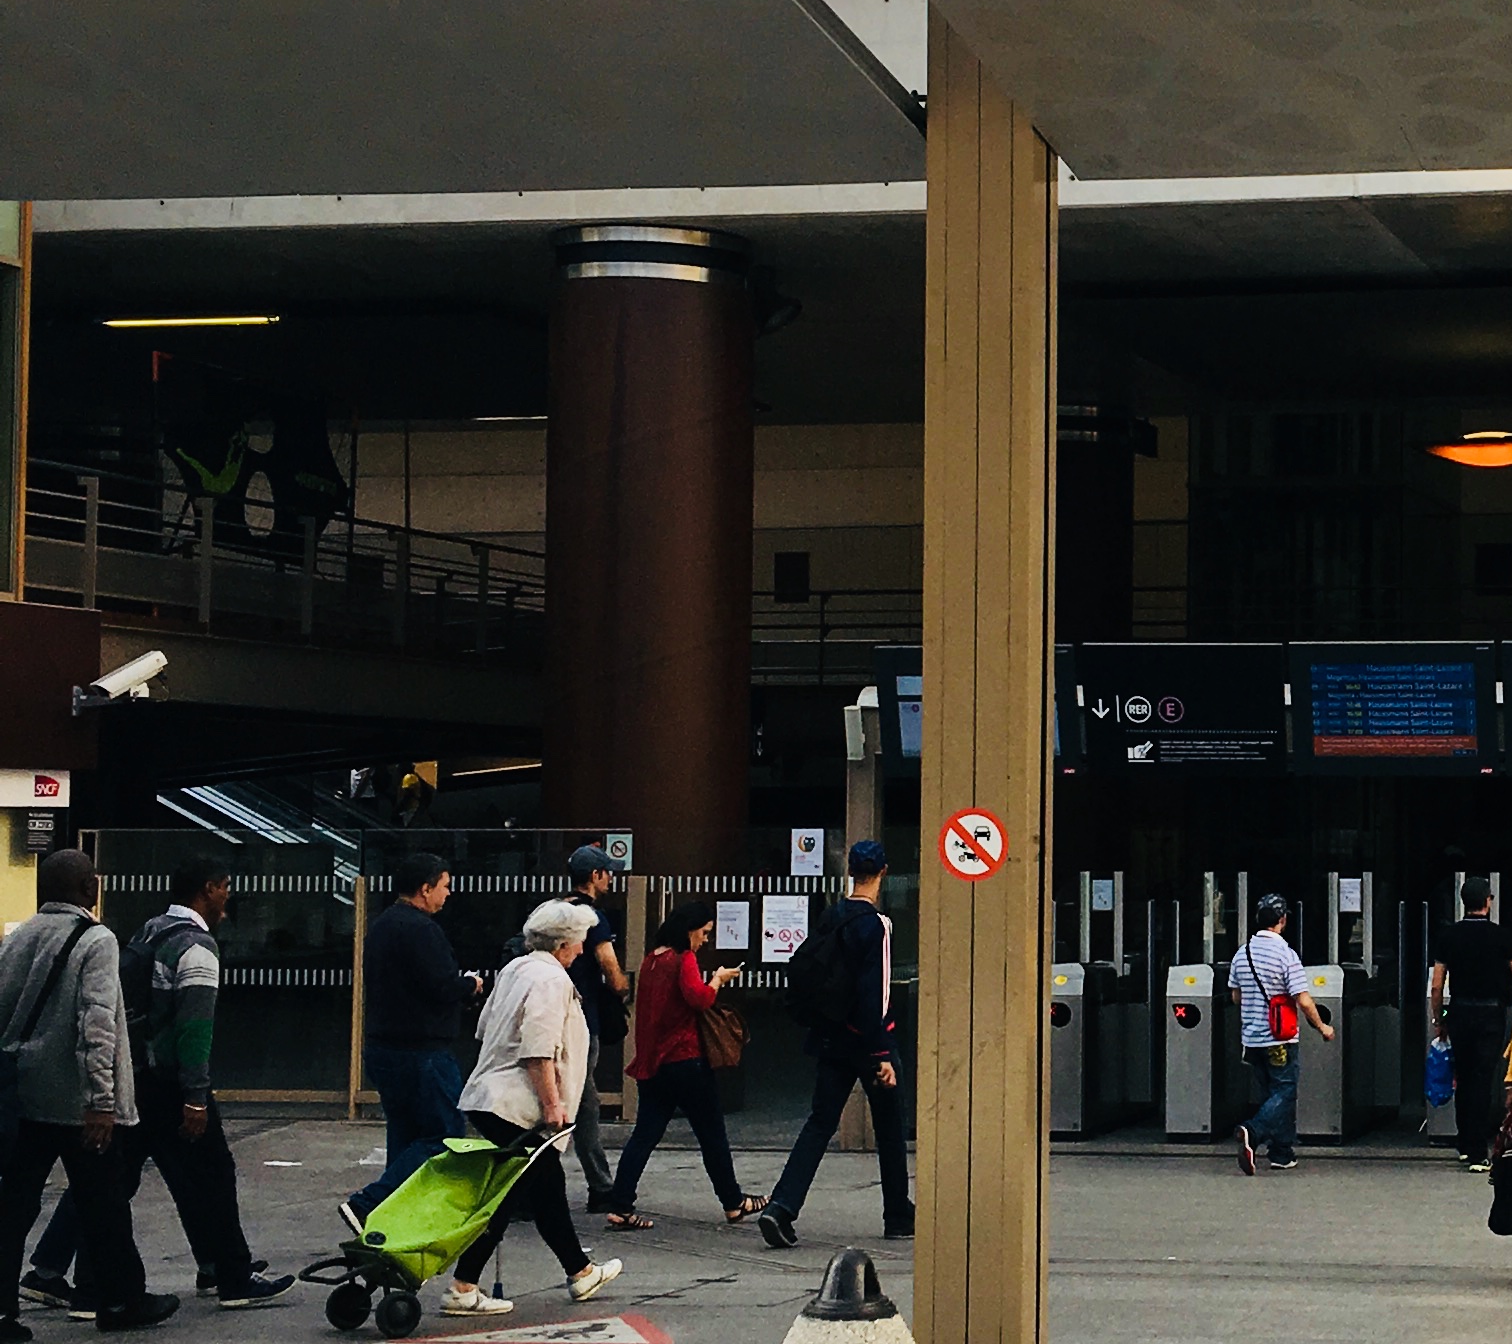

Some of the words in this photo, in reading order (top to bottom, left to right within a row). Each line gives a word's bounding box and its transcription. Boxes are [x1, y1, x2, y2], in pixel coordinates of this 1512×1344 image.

[1128, 704, 1148, 715] RER
[1166, 702, 1176, 716] E
[35, 783, 58, 795] SNCF
